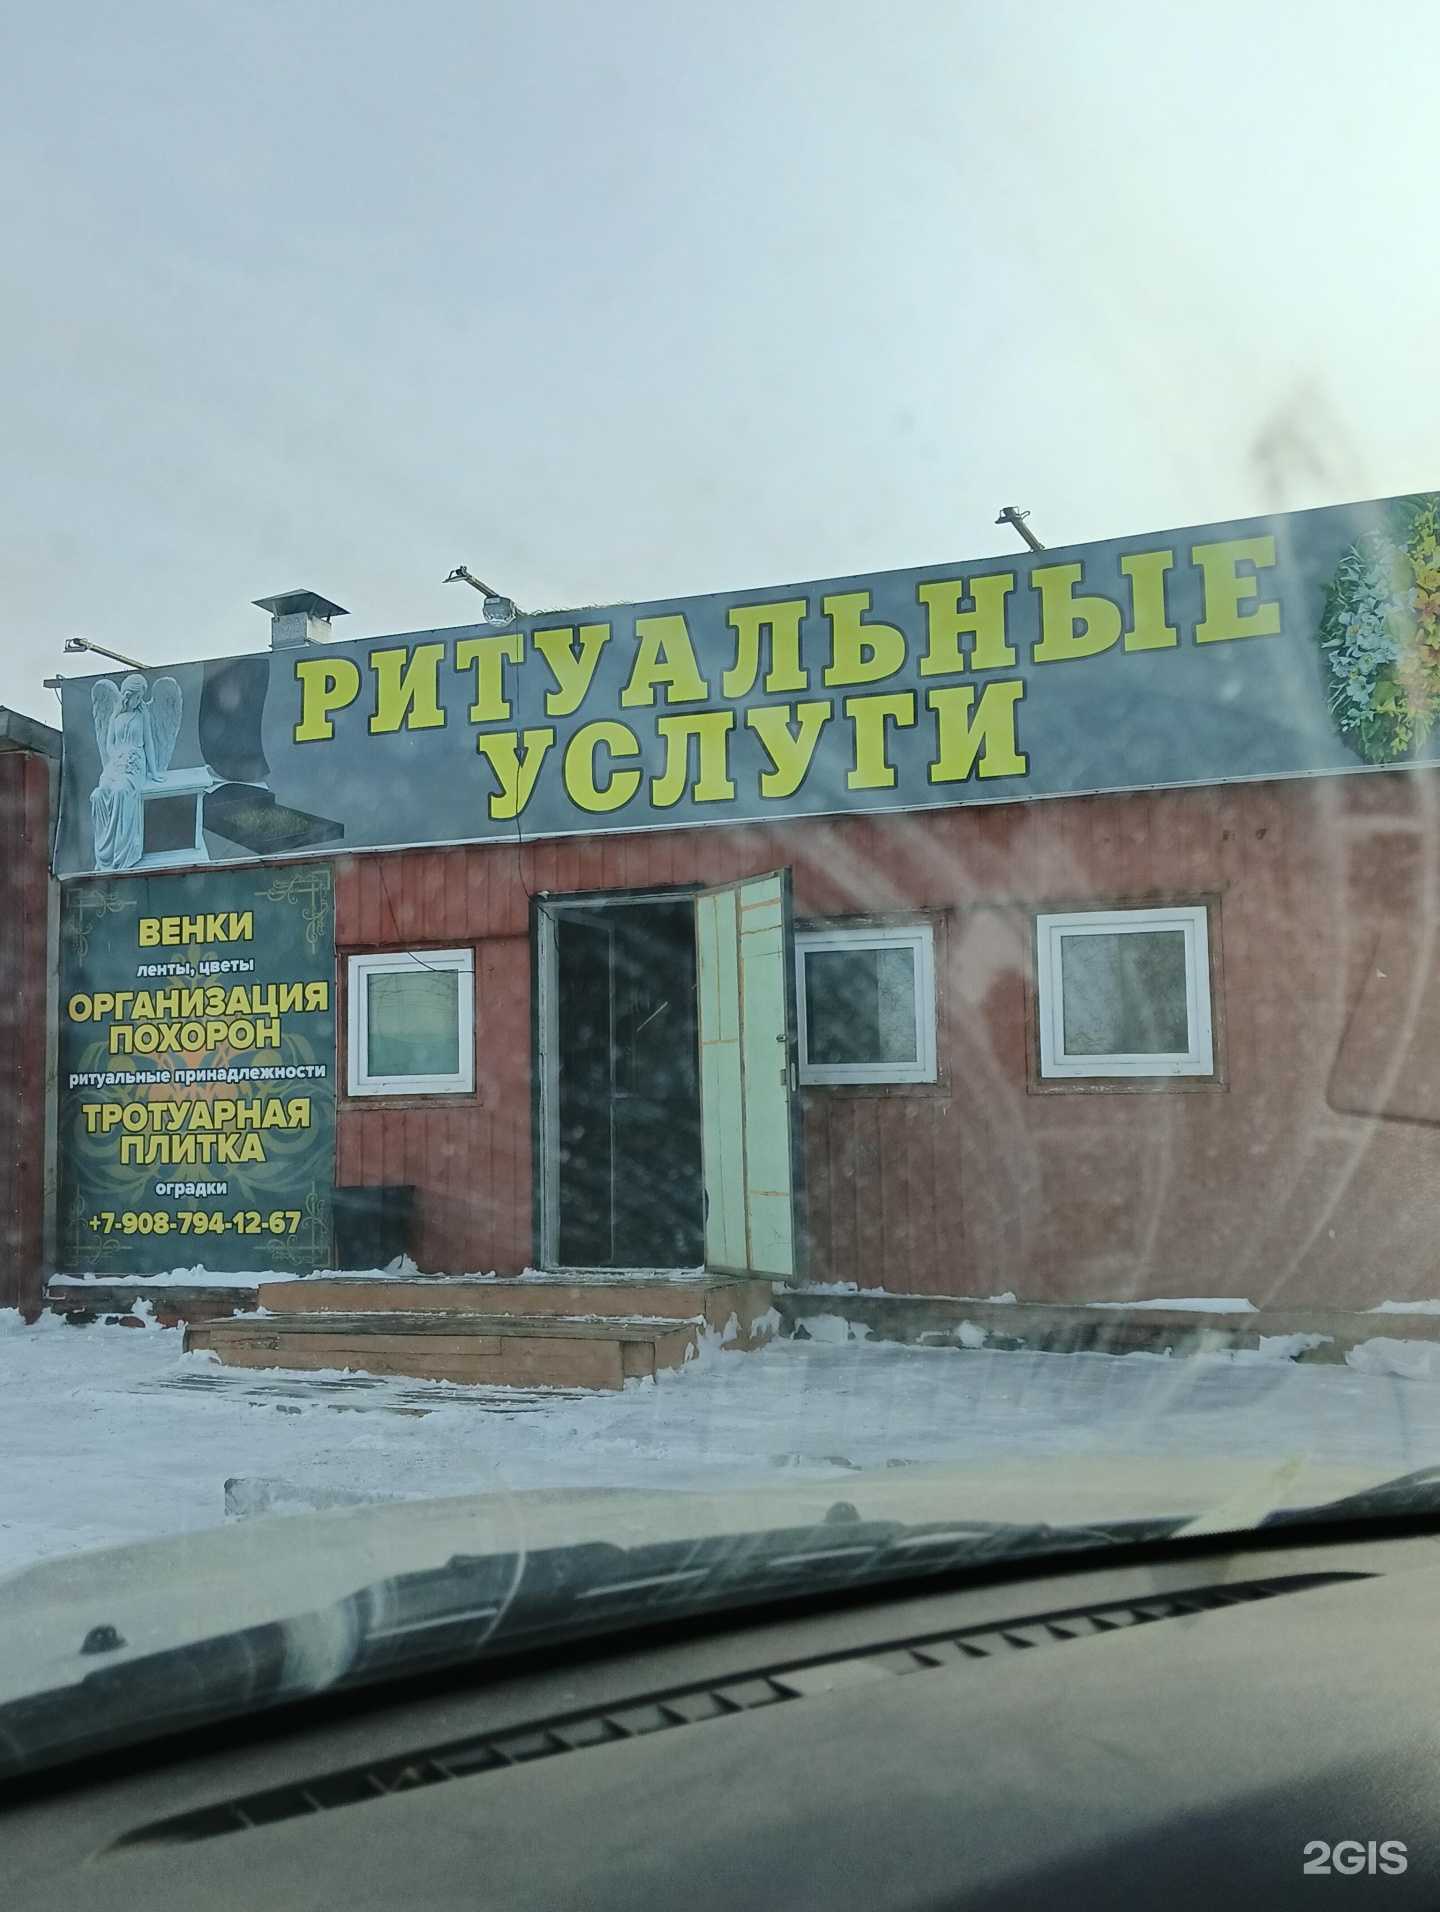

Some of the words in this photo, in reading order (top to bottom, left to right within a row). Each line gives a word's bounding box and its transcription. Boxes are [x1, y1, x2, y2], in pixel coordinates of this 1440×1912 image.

[294, 535, 1282, 743] РИТУАЛЬНЫЕ
[478, 680, 1027, 820] УСЛУГИ
[138, 911, 254, 946] ВЕНКИ
[136, 961, 195, 977] ленты,
[198, 958, 254, 976] цветы
[68, 981, 329, 1022] ОРГАНИЗАЦИЯ
[108, 1018, 281, 1054] ПОХОРОН
[69, 1070, 171, 1088] ритуальные
[175, 1064, 326, 1087] принадлежности
[82, 1099, 311, 1133] ТРОТУАРНАЯ
[120, 1133, 267, 1165] ПЛИТКА
[155, 1181, 227, 1198] оградки
[89, 1211, 301, 1235] +7-908-794-12-67
